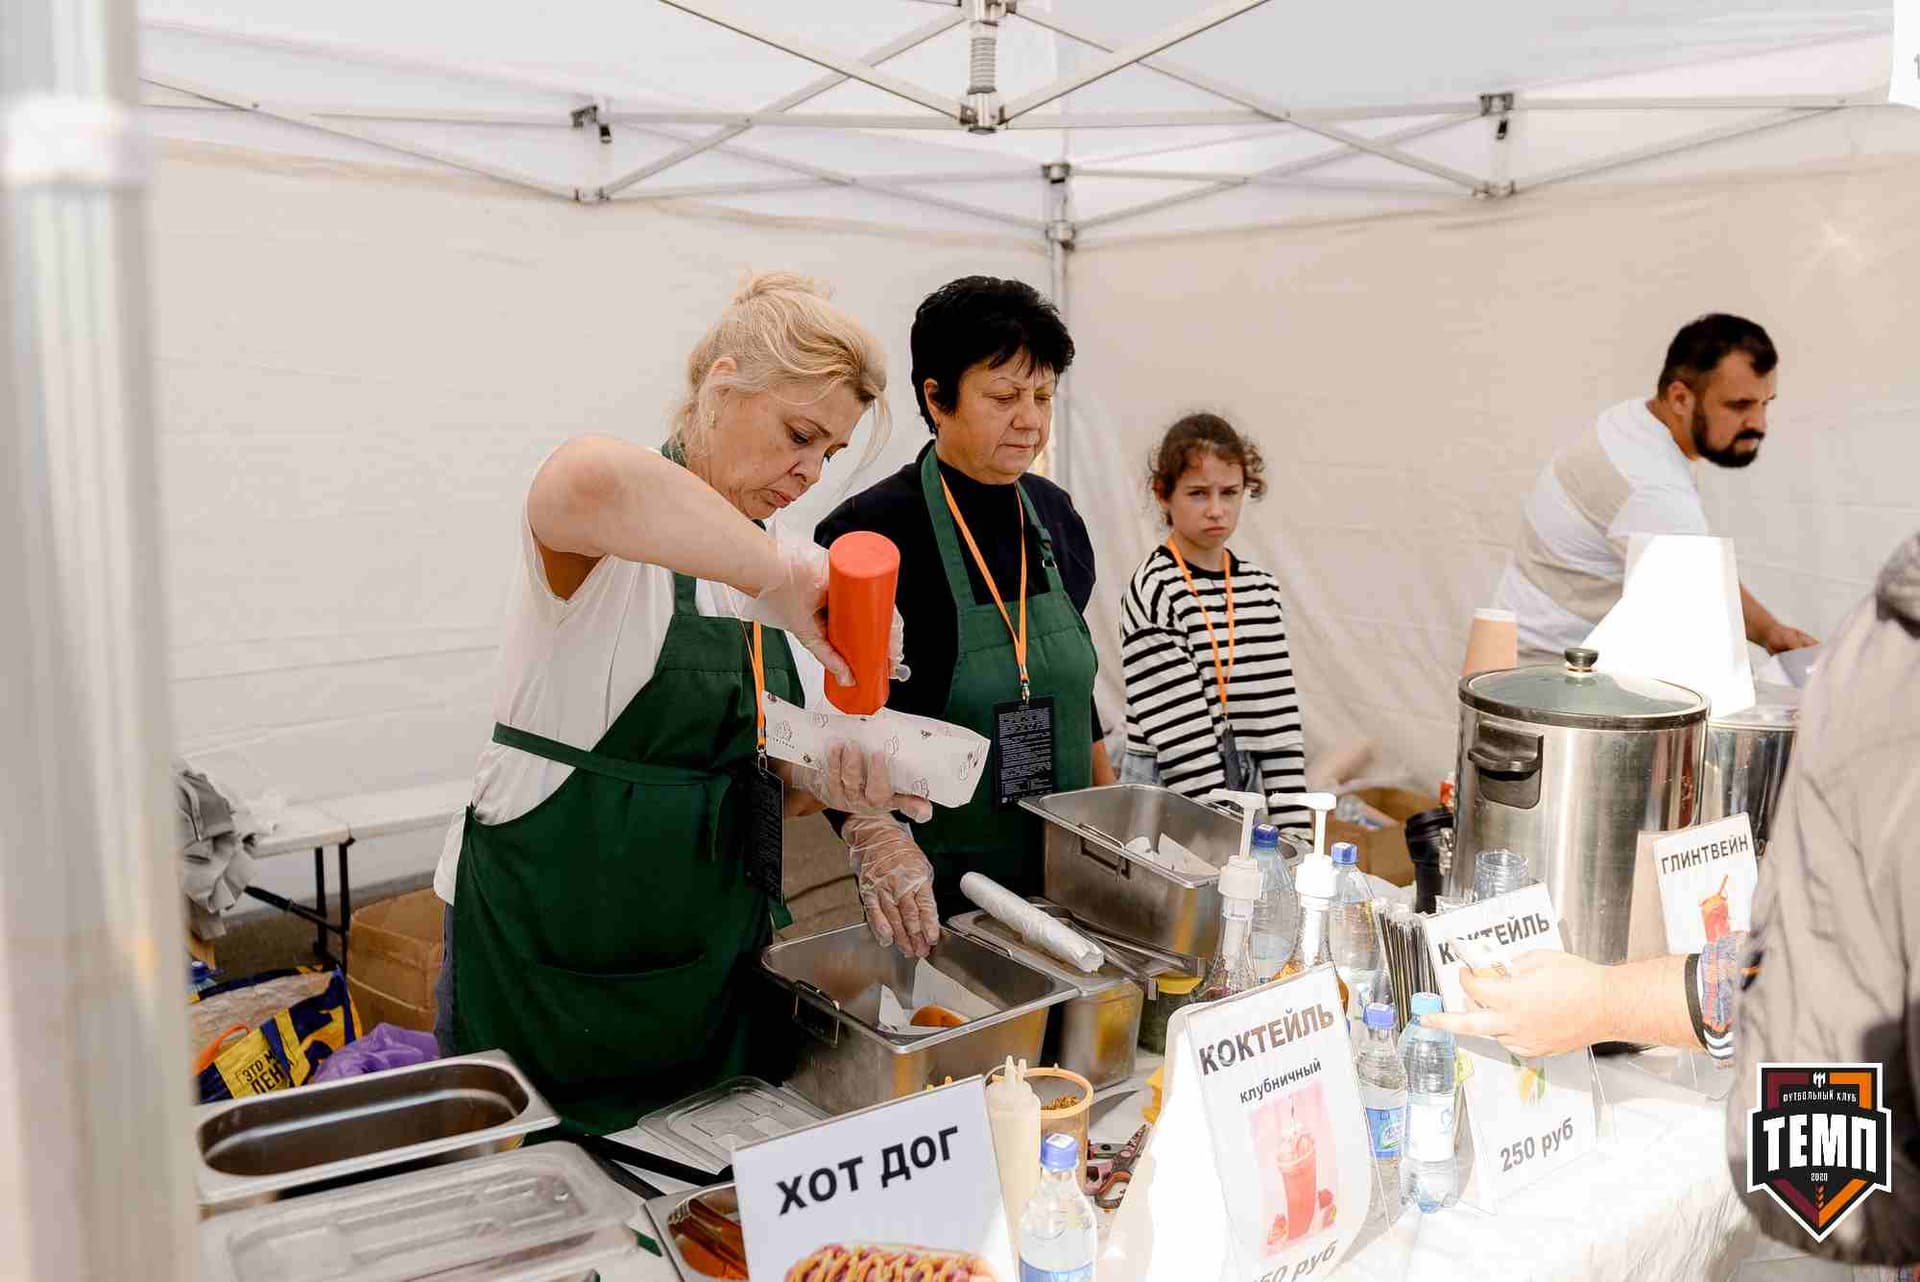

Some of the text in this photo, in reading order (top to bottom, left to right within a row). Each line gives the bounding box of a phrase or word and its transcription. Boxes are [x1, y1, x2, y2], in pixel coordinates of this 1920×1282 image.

[1661, 834, 1748, 875] ГЛИНТВЕЙН
[1438, 912, 1550, 965] КЕЙЛЬ
[1199, 1003, 1334, 1076] КОКТЕЙЛЬ
[242, 1060, 264, 1082] ЭТО
[1240, 1057, 1322, 1103] клубничный
[1500, 1117, 1574, 1172] 250 руб
[775, 1125, 959, 1216] ХОТ ДОГ
[1291, 1239, 1338, 1282] руб
